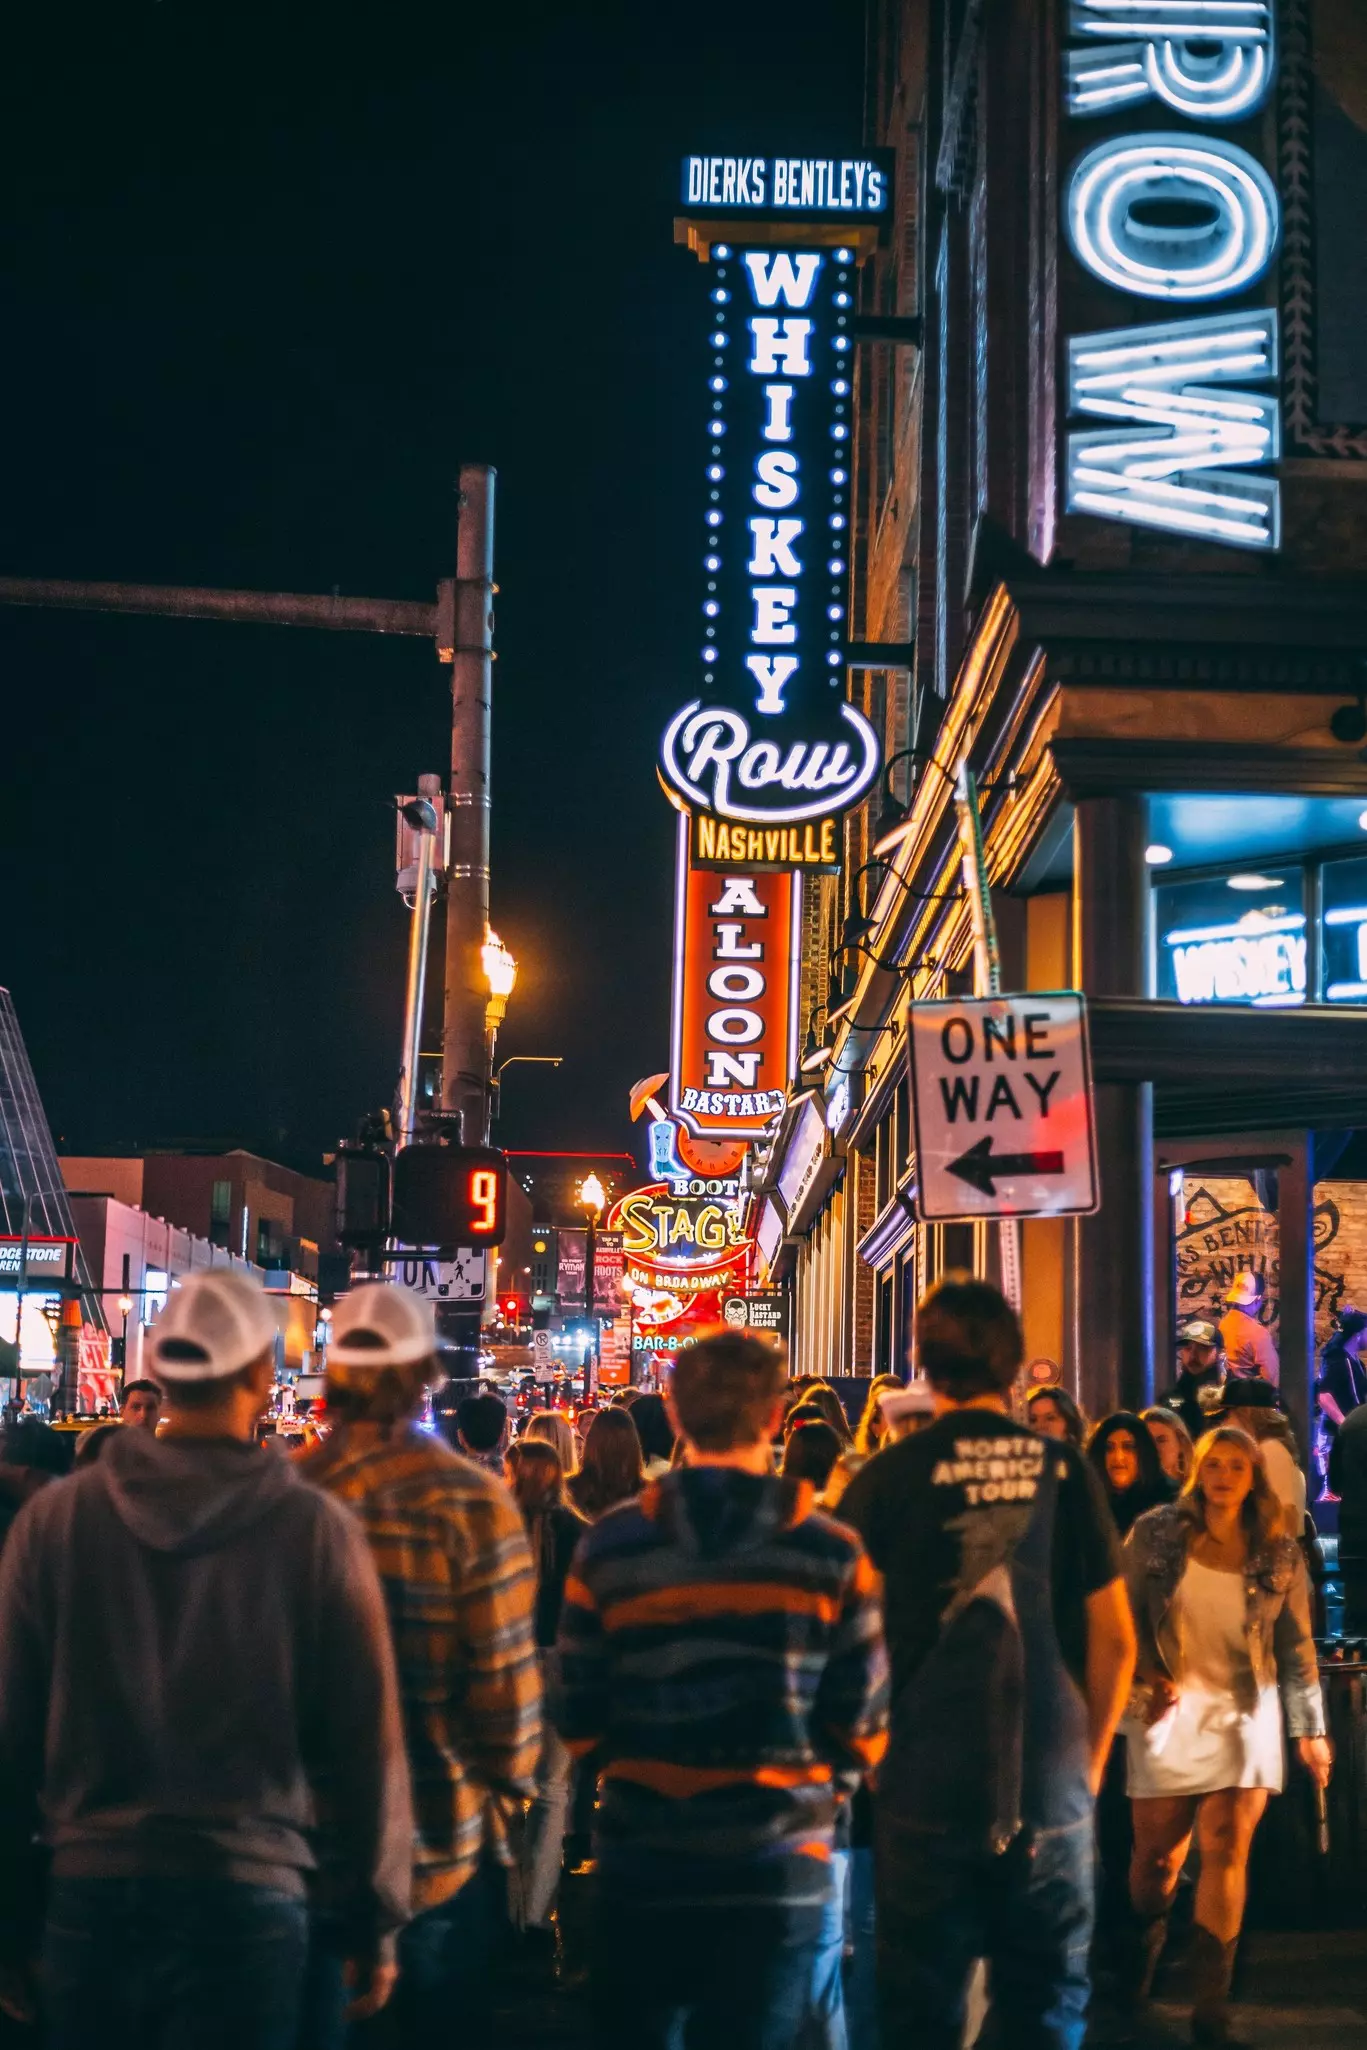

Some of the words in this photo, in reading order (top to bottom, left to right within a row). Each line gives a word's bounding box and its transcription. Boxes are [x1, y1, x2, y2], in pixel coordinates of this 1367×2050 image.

[688, 156, 766, 204] DIERKS
[744, 252, 820, 714] WHISKEY
[682, 708, 858, 818] Row
[698, 815, 836, 863] NASHVILLE
[706, 878, 767, 1087] ALOON
[941, 1012, 1055, 1064] ONE
[939, 1070, 1061, 1123] WAY
[471, 1171, 496, 1230] 9
[558, 1262, 586, 1272] RYMAN
[631, 1268, 649, 1284] ON
[655, 1271, 729, 1289] BROADWAY
[749, 1302, 772, 1311] LUCKY
[749, 1311, 782, 1320] BASTARD
[749, 1319, 777, 1327] SALOON
[965, 1479, 1038, 1505] TOUR
